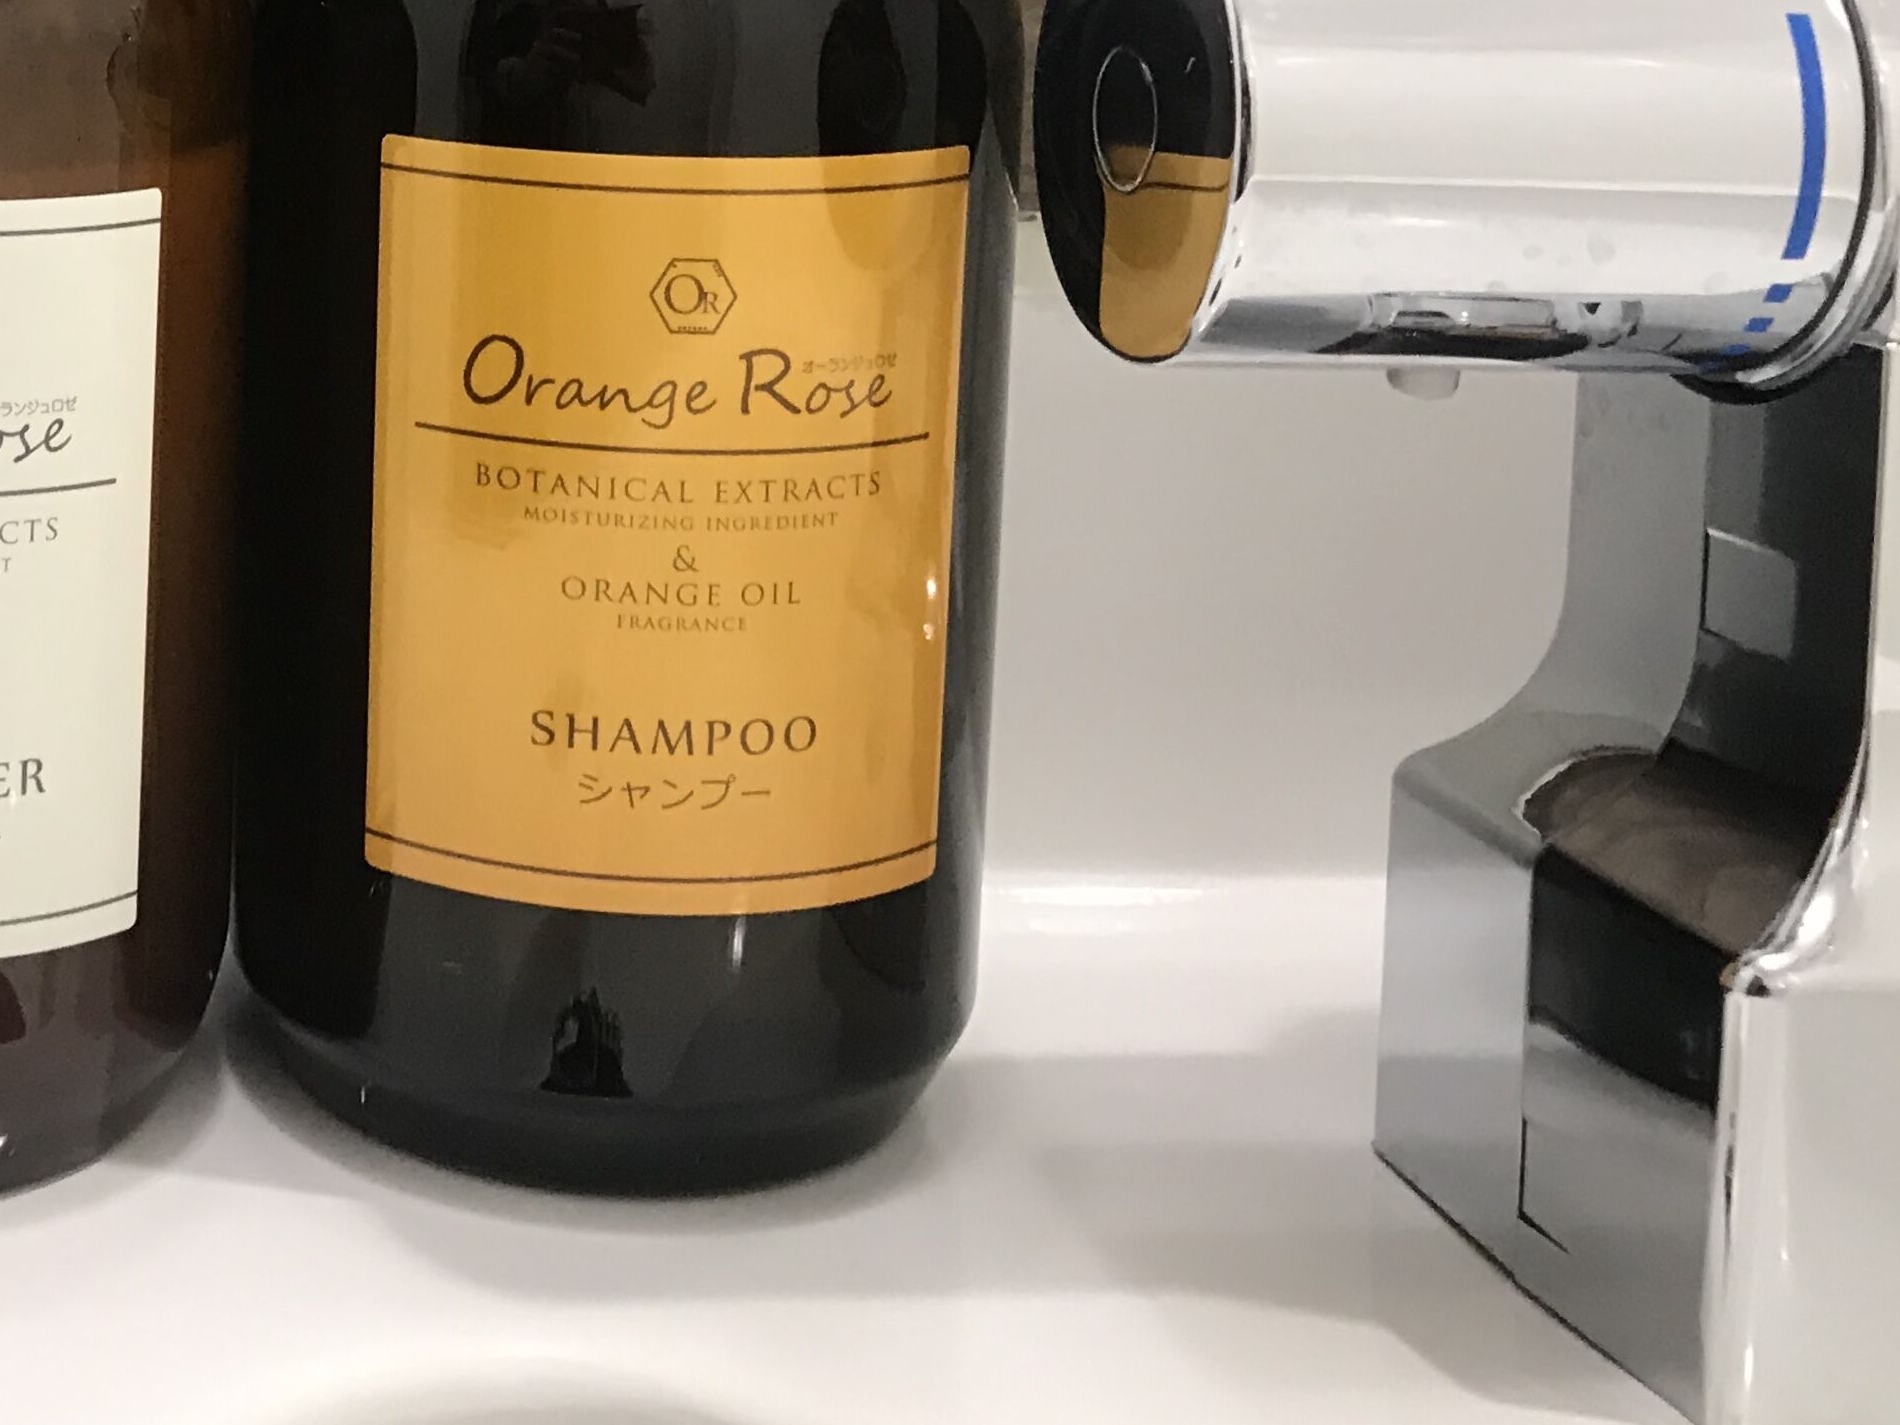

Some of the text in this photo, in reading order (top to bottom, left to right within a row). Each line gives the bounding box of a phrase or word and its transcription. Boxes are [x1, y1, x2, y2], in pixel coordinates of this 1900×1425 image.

[462, 334, 890, 428] Orange Rose
[475, 462, 880, 503] BOTANICAL EXTRACTS
[523, 505, 837, 531] MOISTURIZING INGREDIENT
[671, 544, 698, 572] &
[560, 576, 800, 606] ORANGE OIL
[616, 614, 746, 631] FRAGRANCE
[530, 709, 816, 756] SHAMPOO
[576, 772, 770, 809] シャンプー
